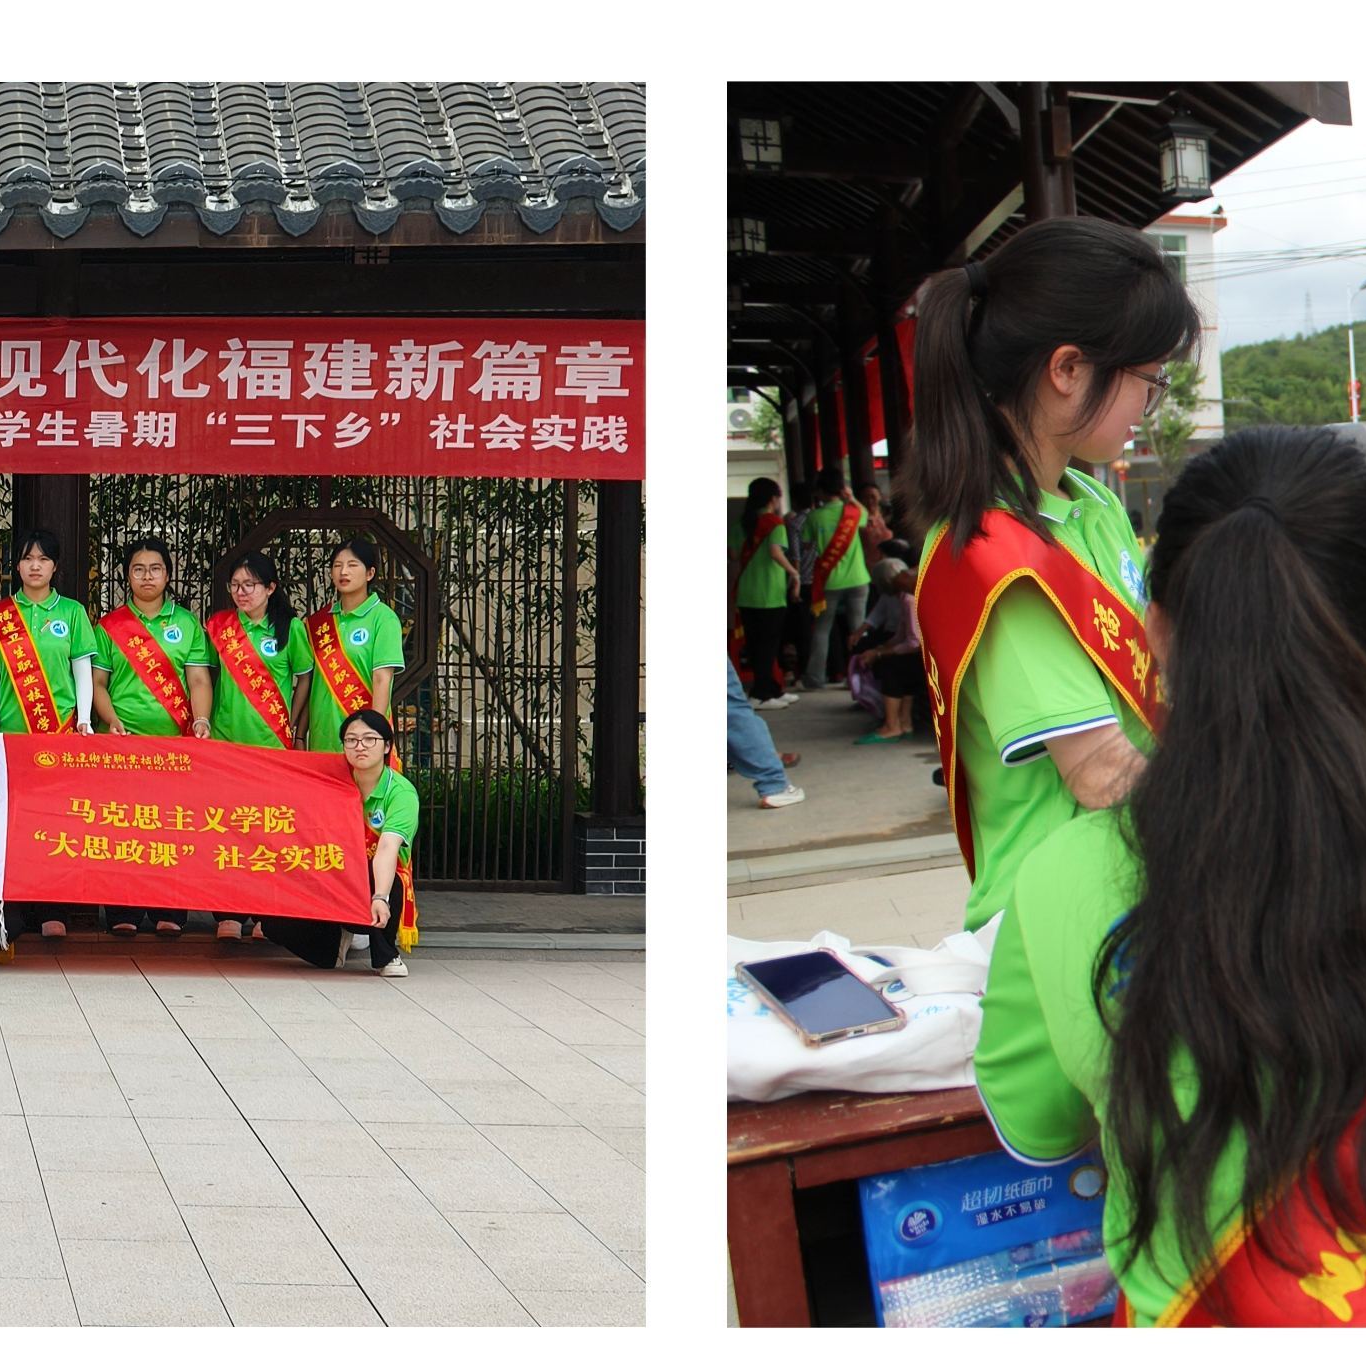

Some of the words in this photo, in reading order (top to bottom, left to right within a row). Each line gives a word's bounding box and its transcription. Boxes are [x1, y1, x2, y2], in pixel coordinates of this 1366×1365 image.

[429, 412, 628, 453] 社会实践
[67, 797, 296, 834] 马克思主义学院
[214, 842, 346, 873] 社会实践
